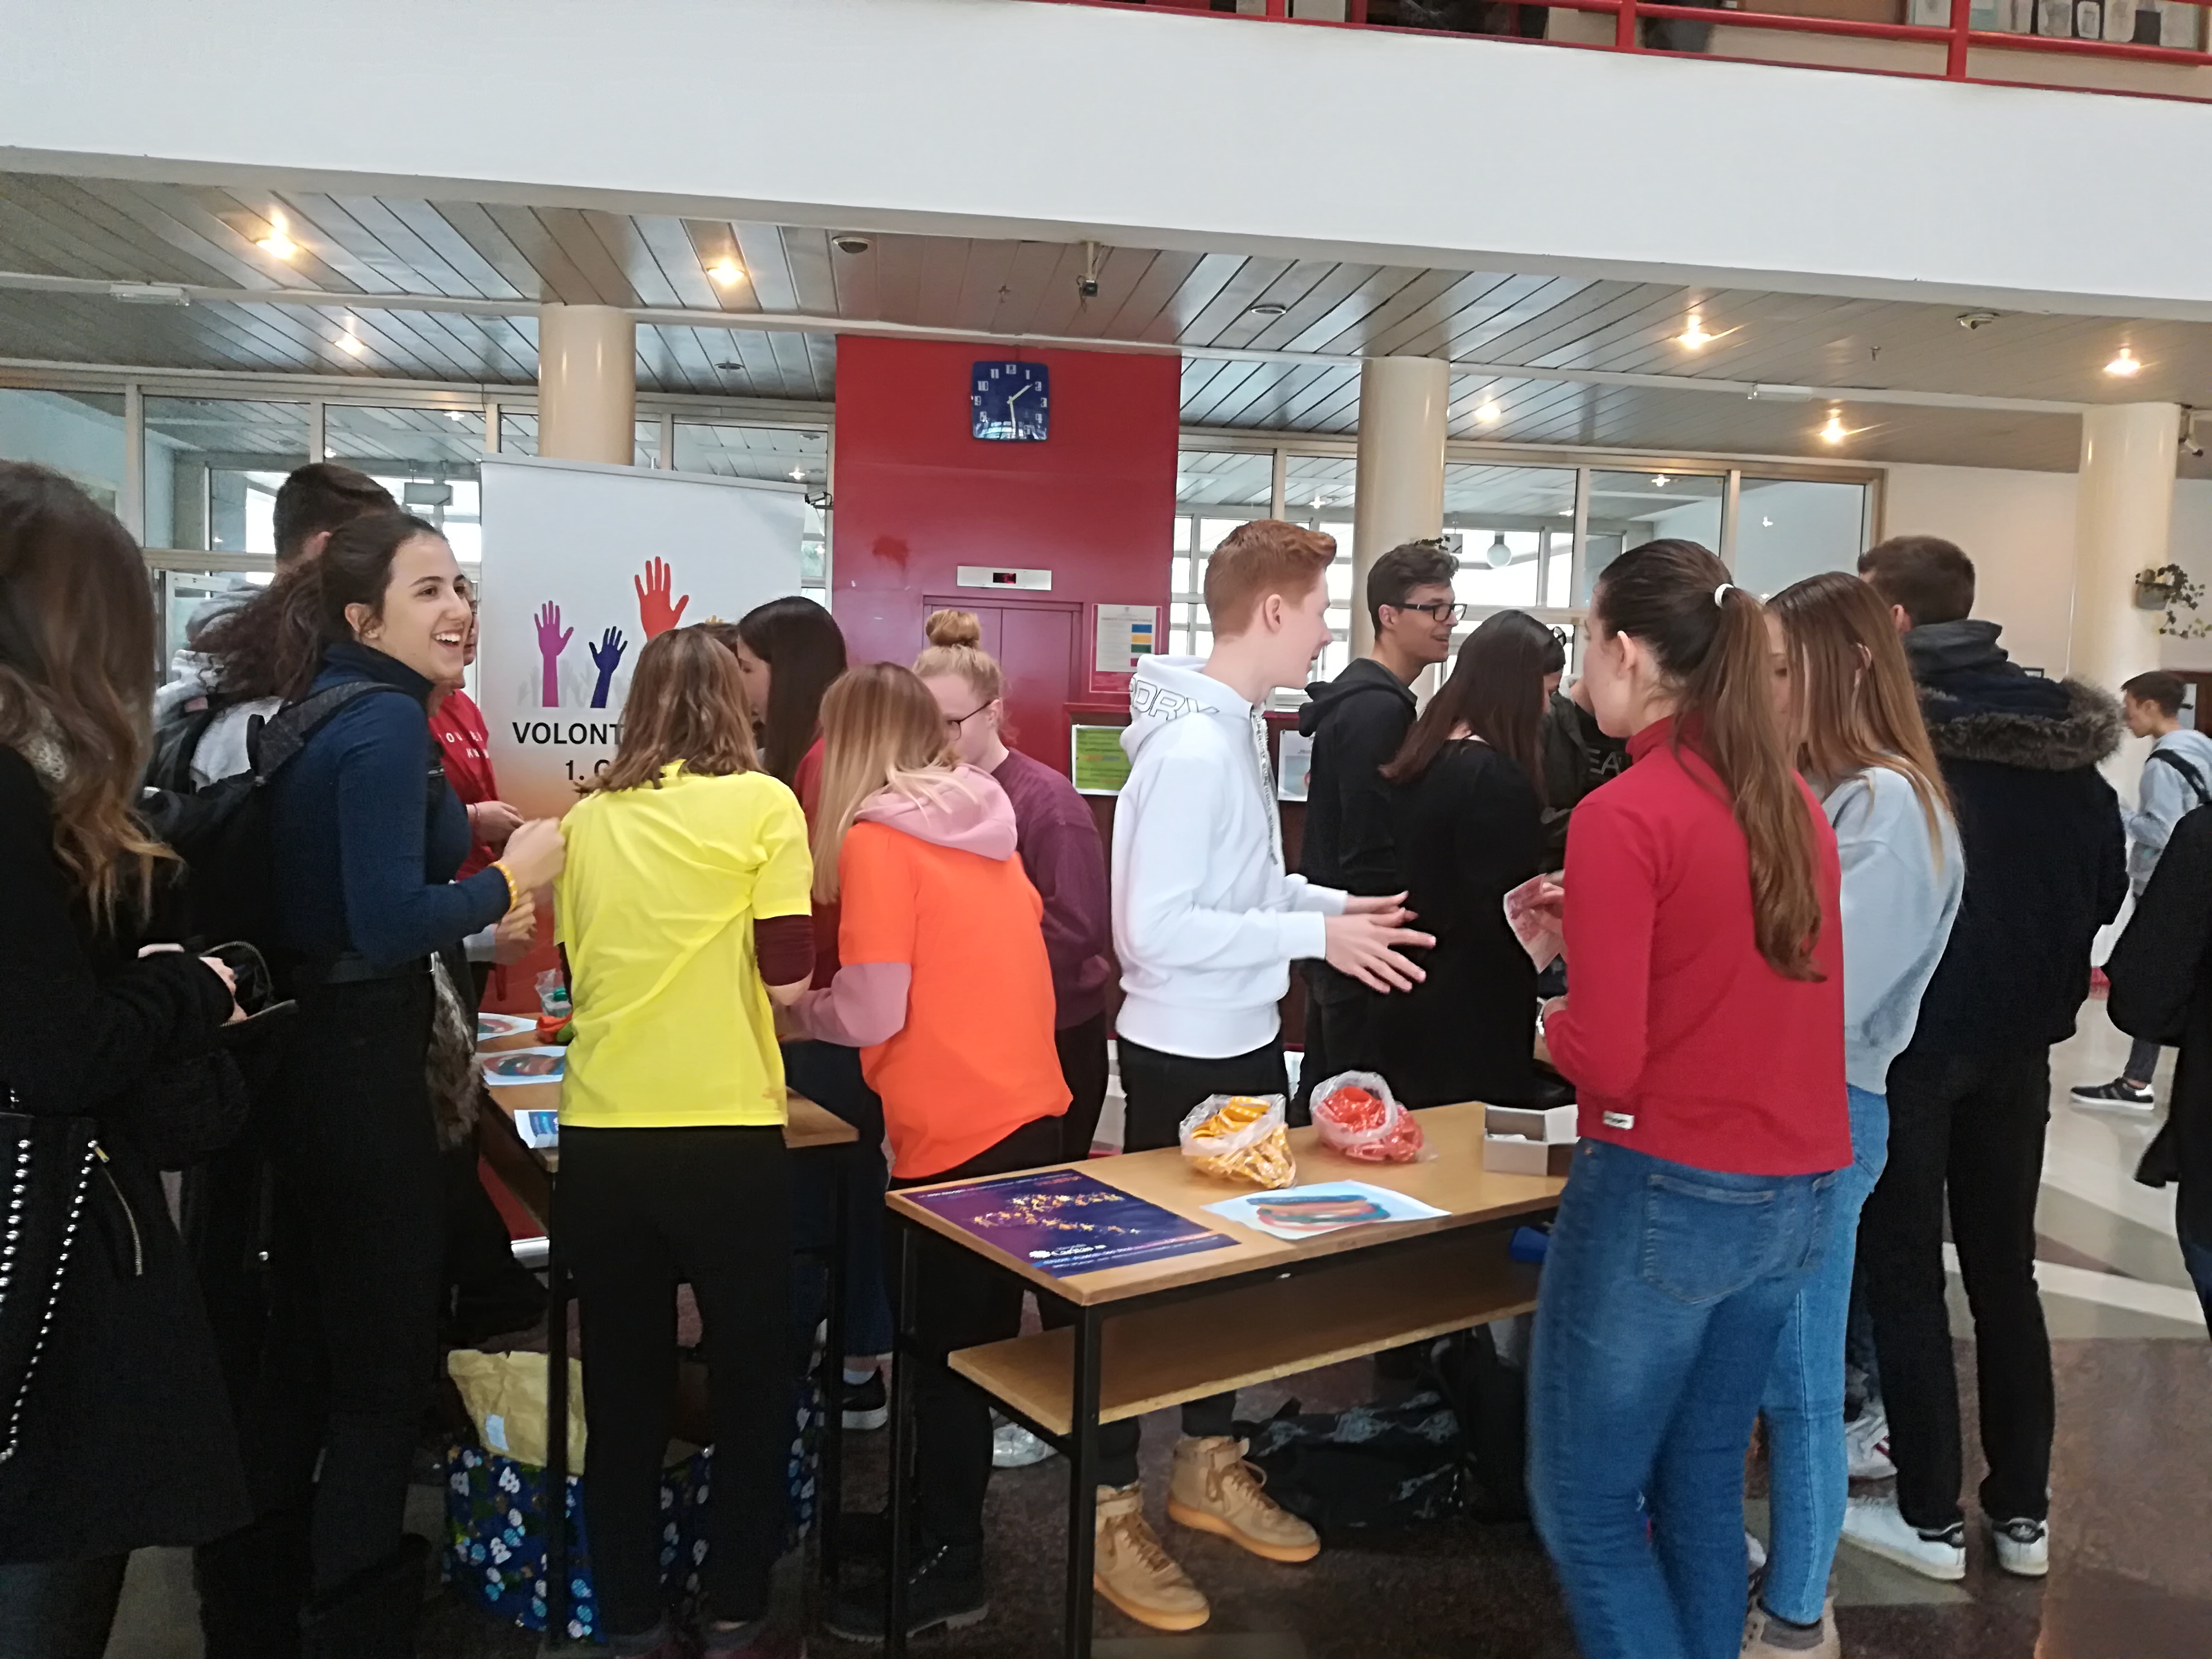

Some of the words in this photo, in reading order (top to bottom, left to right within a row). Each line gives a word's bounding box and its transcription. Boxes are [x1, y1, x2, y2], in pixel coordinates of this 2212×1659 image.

[990, 368, 999, 379] 11
[1006, 364, 1017, 375] 12
[1025, 369, 1030, 380] 1
[978, 381, 989, 391] 10
[1035, 381, 1042, 391] 2
[974, 395, 981, 406] 9
[1040, 397, 1047, 408] 3
[1035, 413, 1042, 424] 4
[565, 759, 585, 781] 1.
